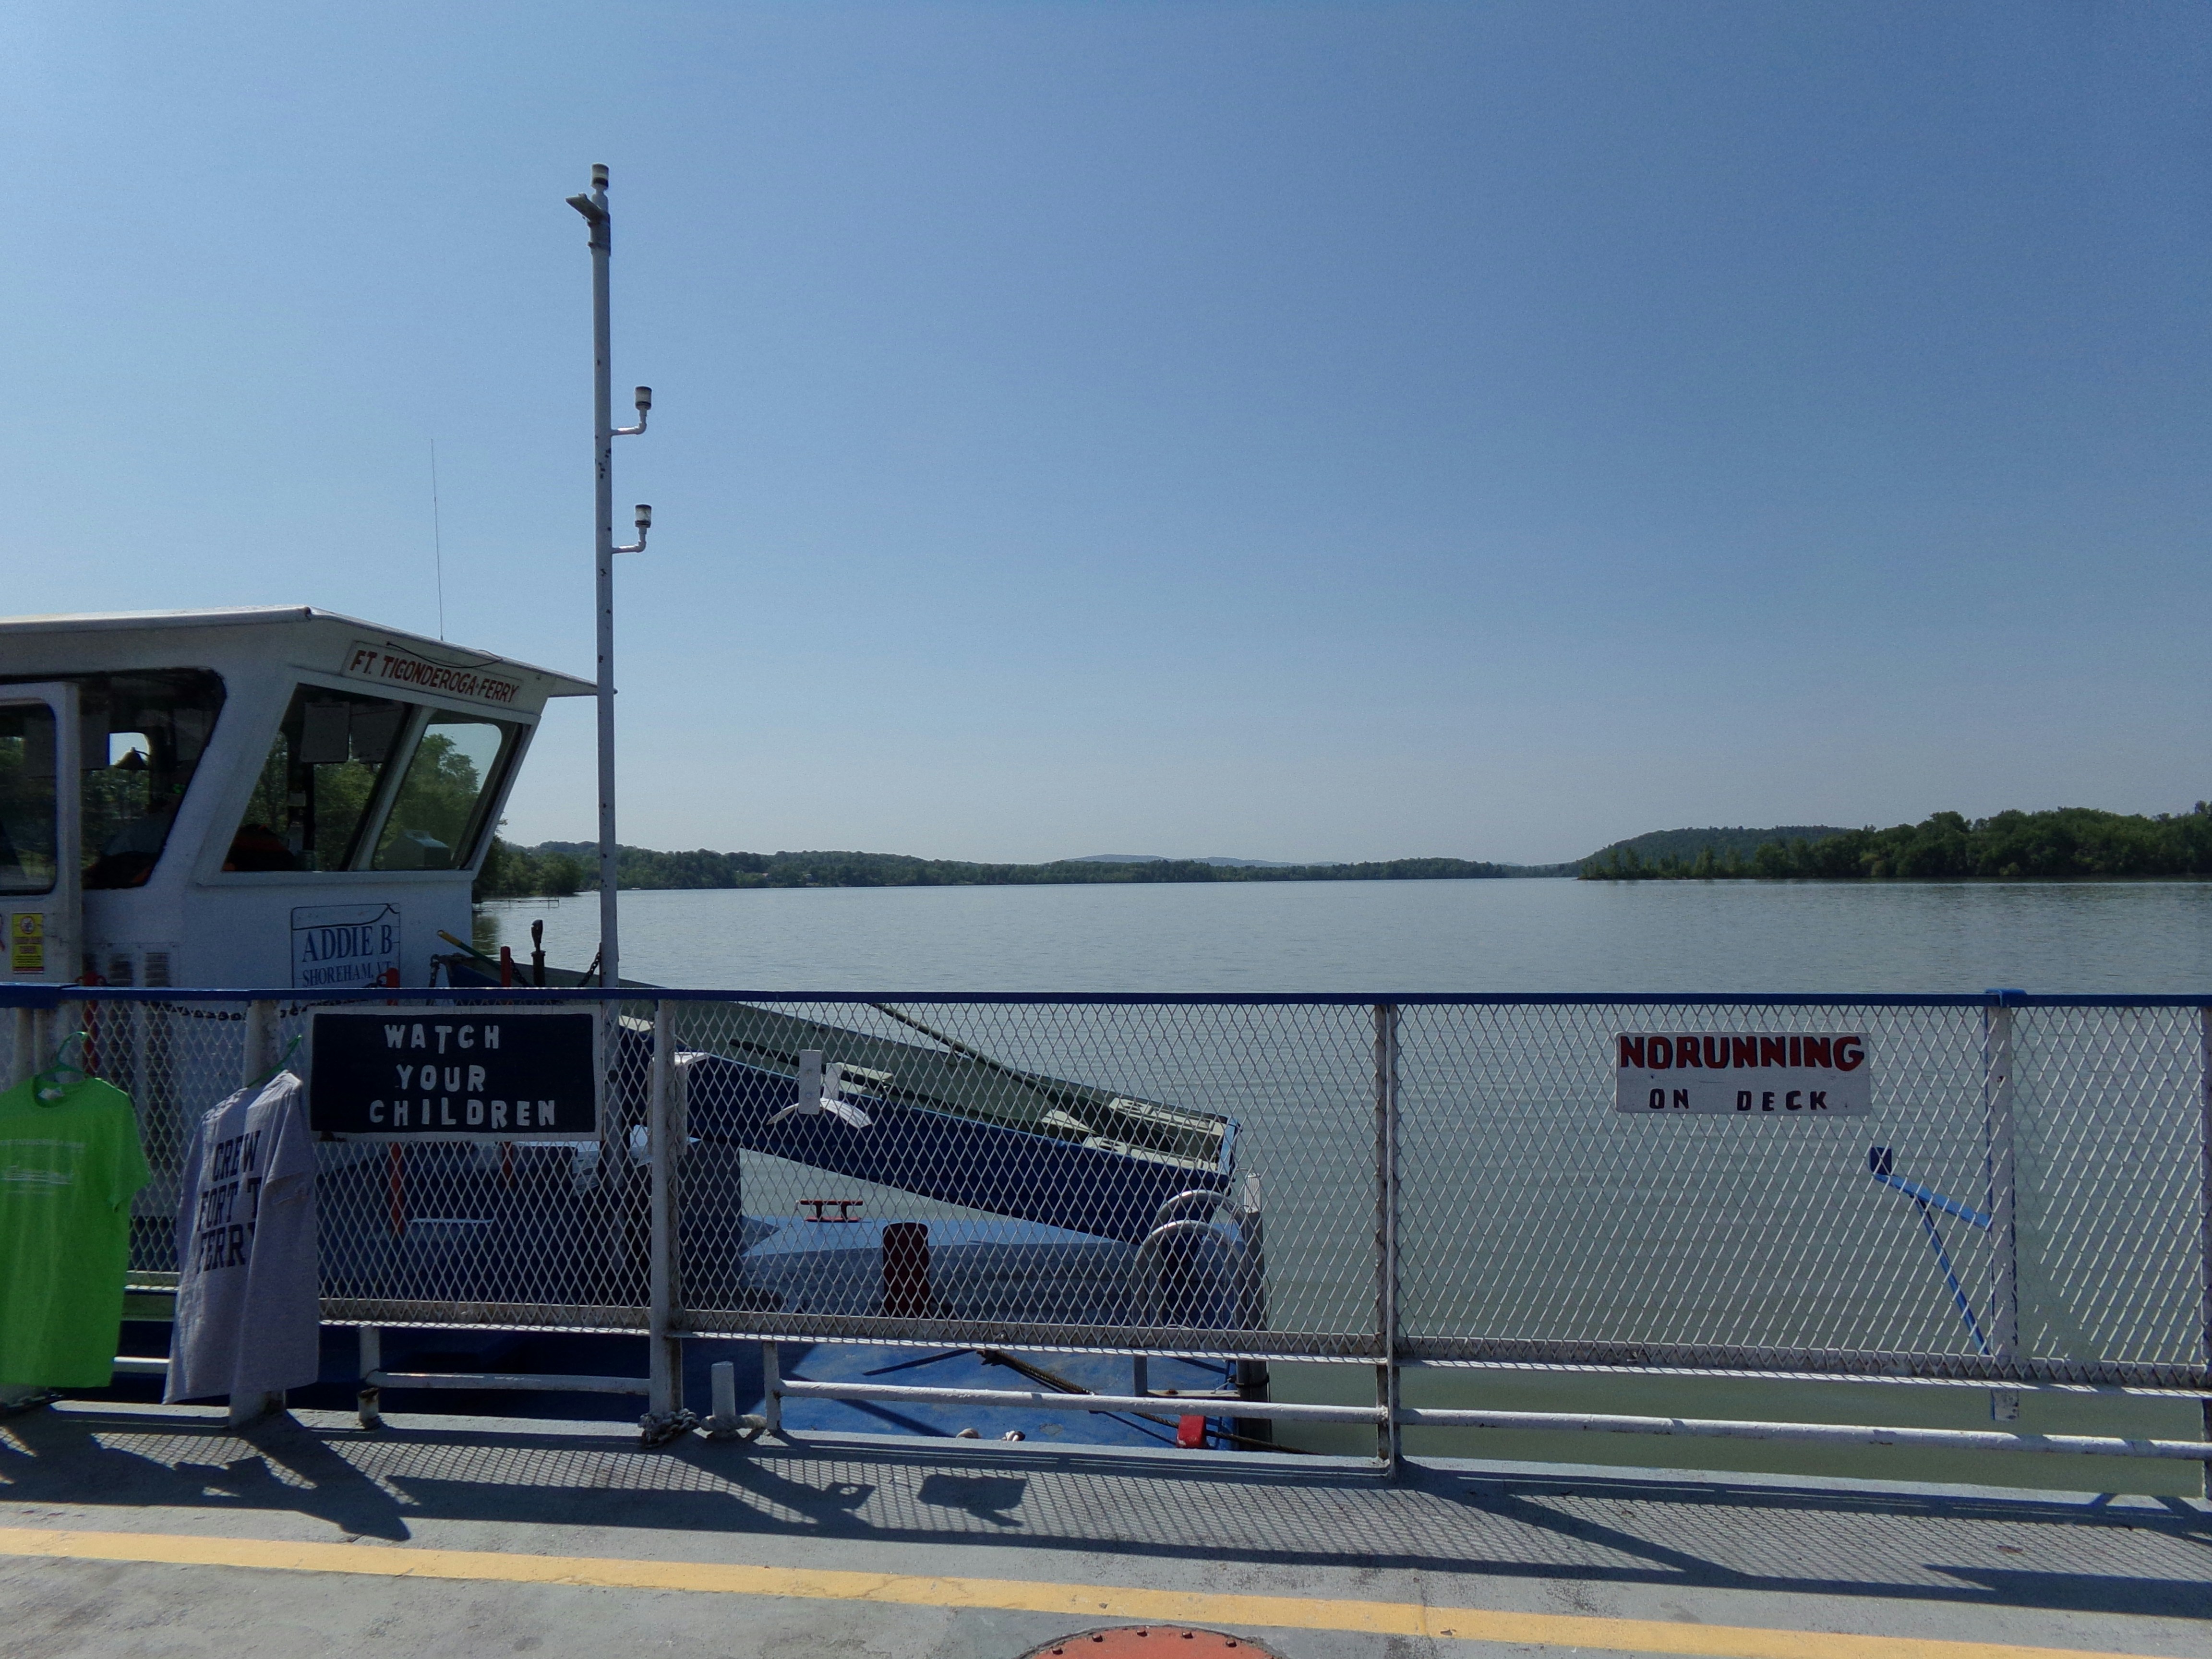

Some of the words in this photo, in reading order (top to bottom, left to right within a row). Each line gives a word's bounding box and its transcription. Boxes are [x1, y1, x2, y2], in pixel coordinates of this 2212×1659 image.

[478, 678, 519, 703] FERRY
[302, 926, 373, 962] ADDIE
[380, 925, 392, 955] B
[384, 1023, 499, 1054] WATCH
[396, 1064, 486, 1092] YOUR
[369, 1097, 554, 1129] CHILDREN
[1649, 1089, 1689, 1109] ON
[1737, 1090, 1828, 1111] DECK
[213, 1130, 261, 1182] CREW
[197, 1180, 239, 1232] FORT
[196, 1221, 256, 1274] FERR
